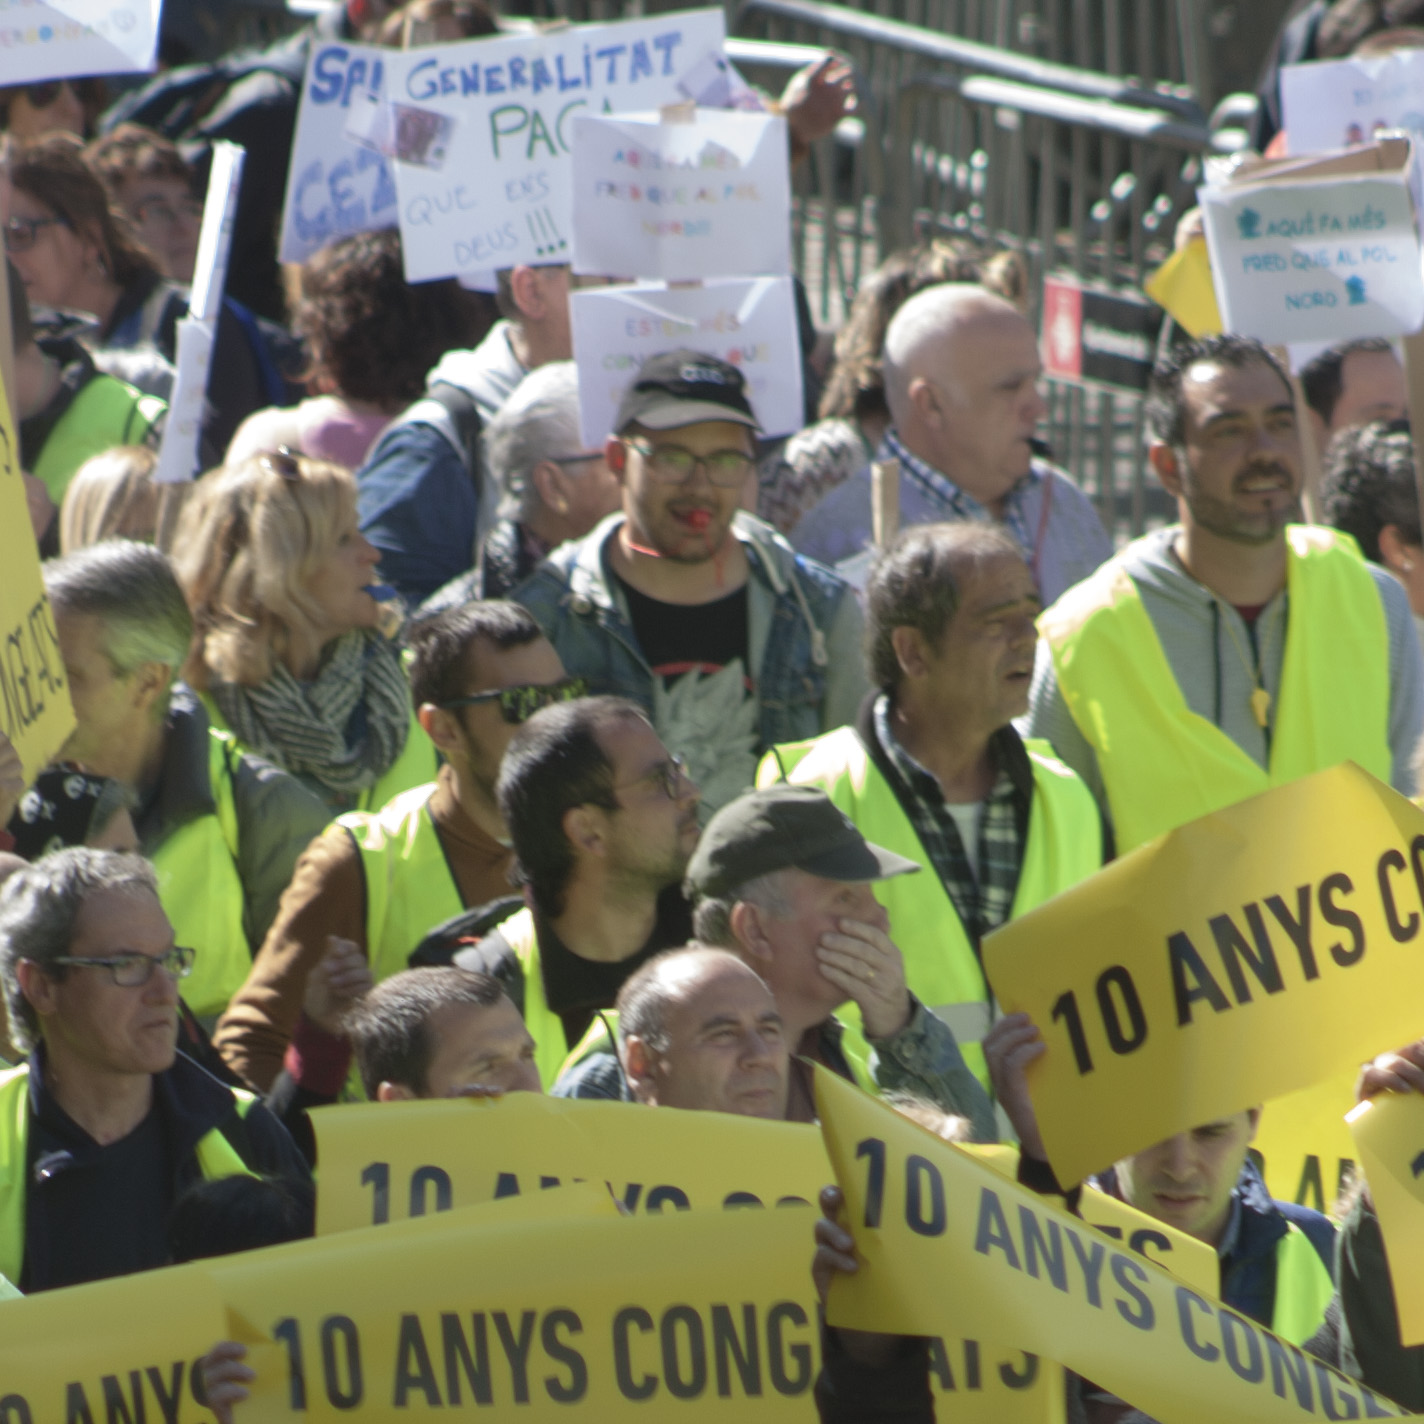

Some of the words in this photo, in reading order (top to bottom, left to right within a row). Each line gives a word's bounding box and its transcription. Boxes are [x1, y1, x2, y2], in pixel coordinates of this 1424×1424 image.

[404, 183, 473, 228] QUE
[504, 170, 550, 202] ENS
[454, 225, 519, 266] DEUS
[1049, 962, 1150, 1077] 10
[1167, 870, 1367, 1028] ANYS
[855, 1136, 948, 1238] 10
[973, 1186, 1157, 1333] ANYS
[271, 1314, 364, 1412] 10
[392, 1307, 589, 1409] ANYS
